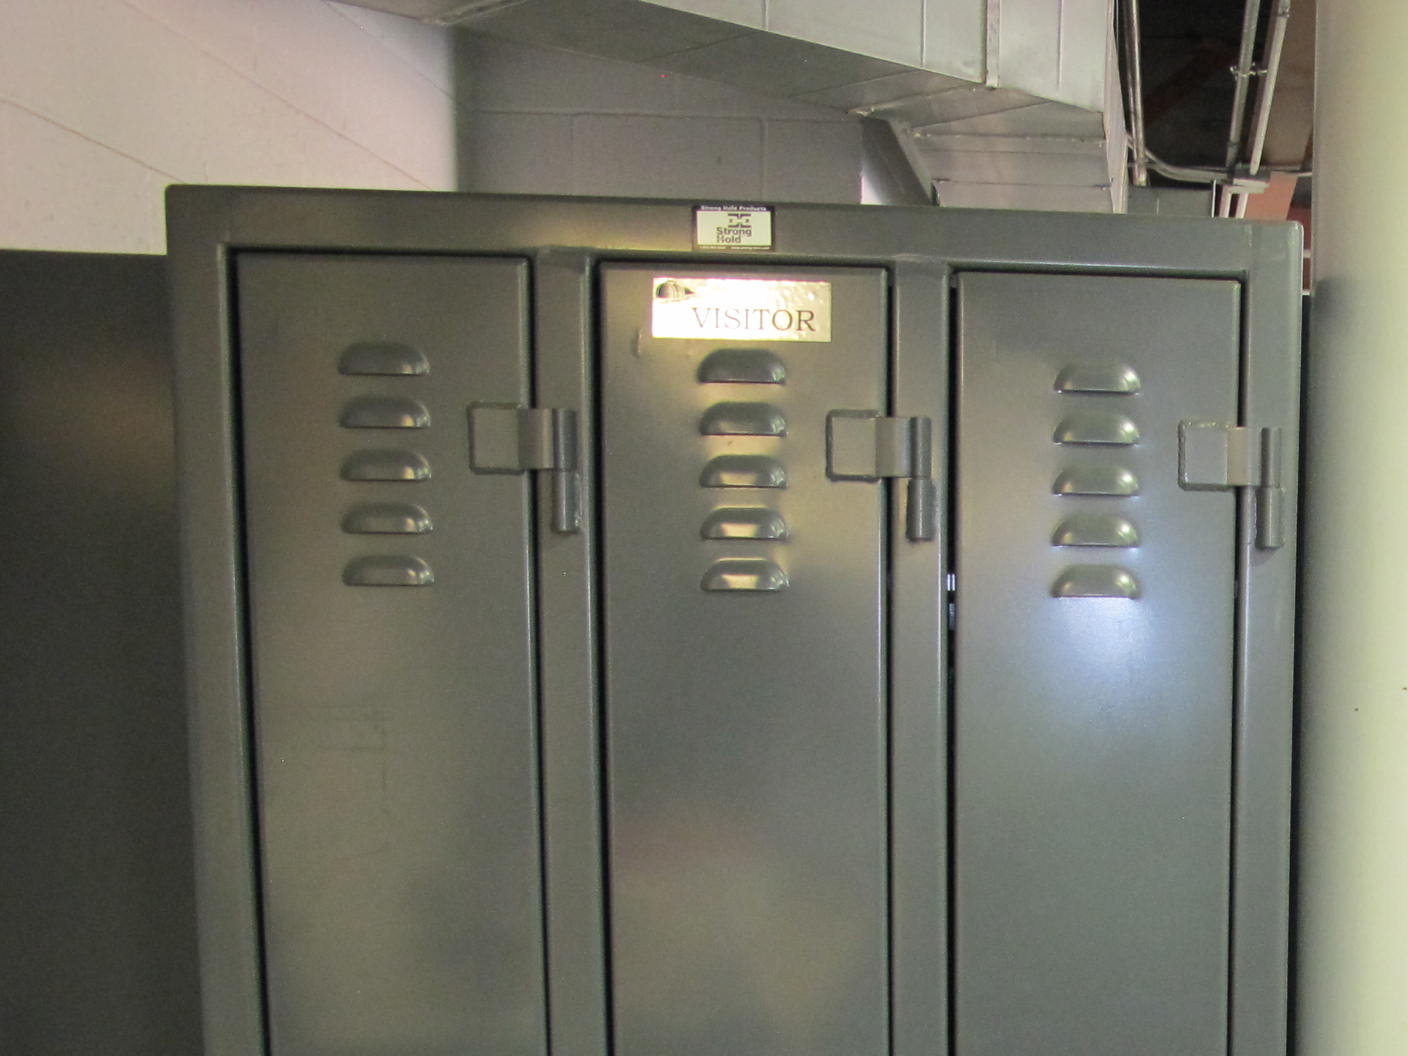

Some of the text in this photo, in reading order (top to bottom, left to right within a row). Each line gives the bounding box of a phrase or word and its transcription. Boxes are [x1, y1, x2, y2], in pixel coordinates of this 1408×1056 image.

[716, 227, 752, 237] Strong
[716, 235, 742, 244] Hold
[691, 306, 817, 332] VISITOR
